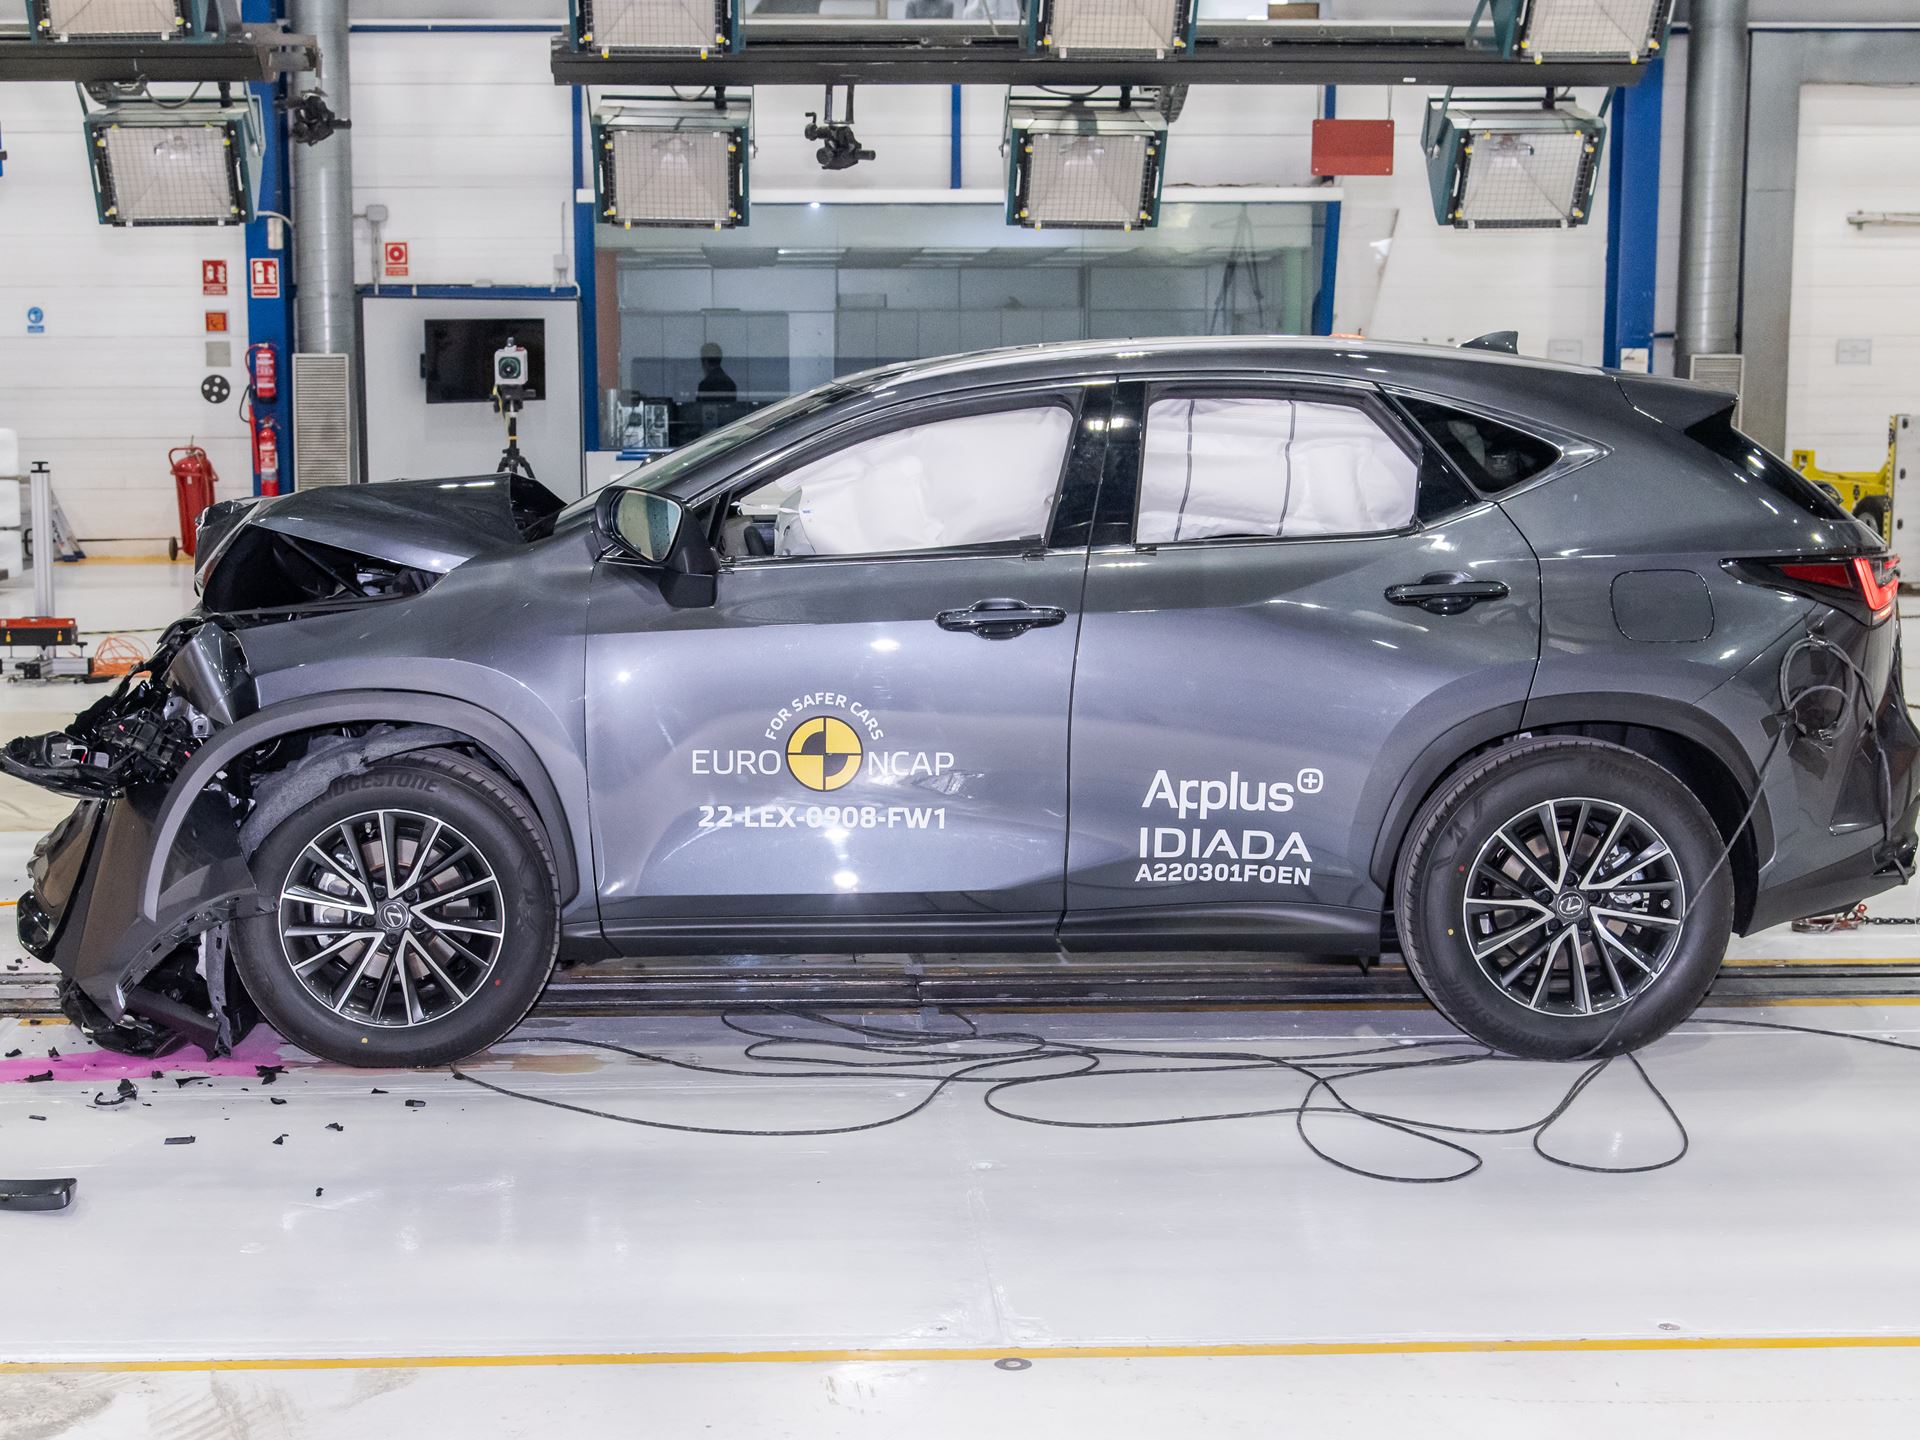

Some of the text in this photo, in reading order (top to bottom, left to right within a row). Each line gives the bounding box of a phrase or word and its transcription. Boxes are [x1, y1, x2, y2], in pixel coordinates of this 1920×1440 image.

[764, 692, 884, 741] FOR SAFER CARS
[692, 750, 955, 776] EURO NCAP
[698, 805, 946, 829] 22-LEX-0908-FW1
[1139, 827, 1313, 862] IDIADA
